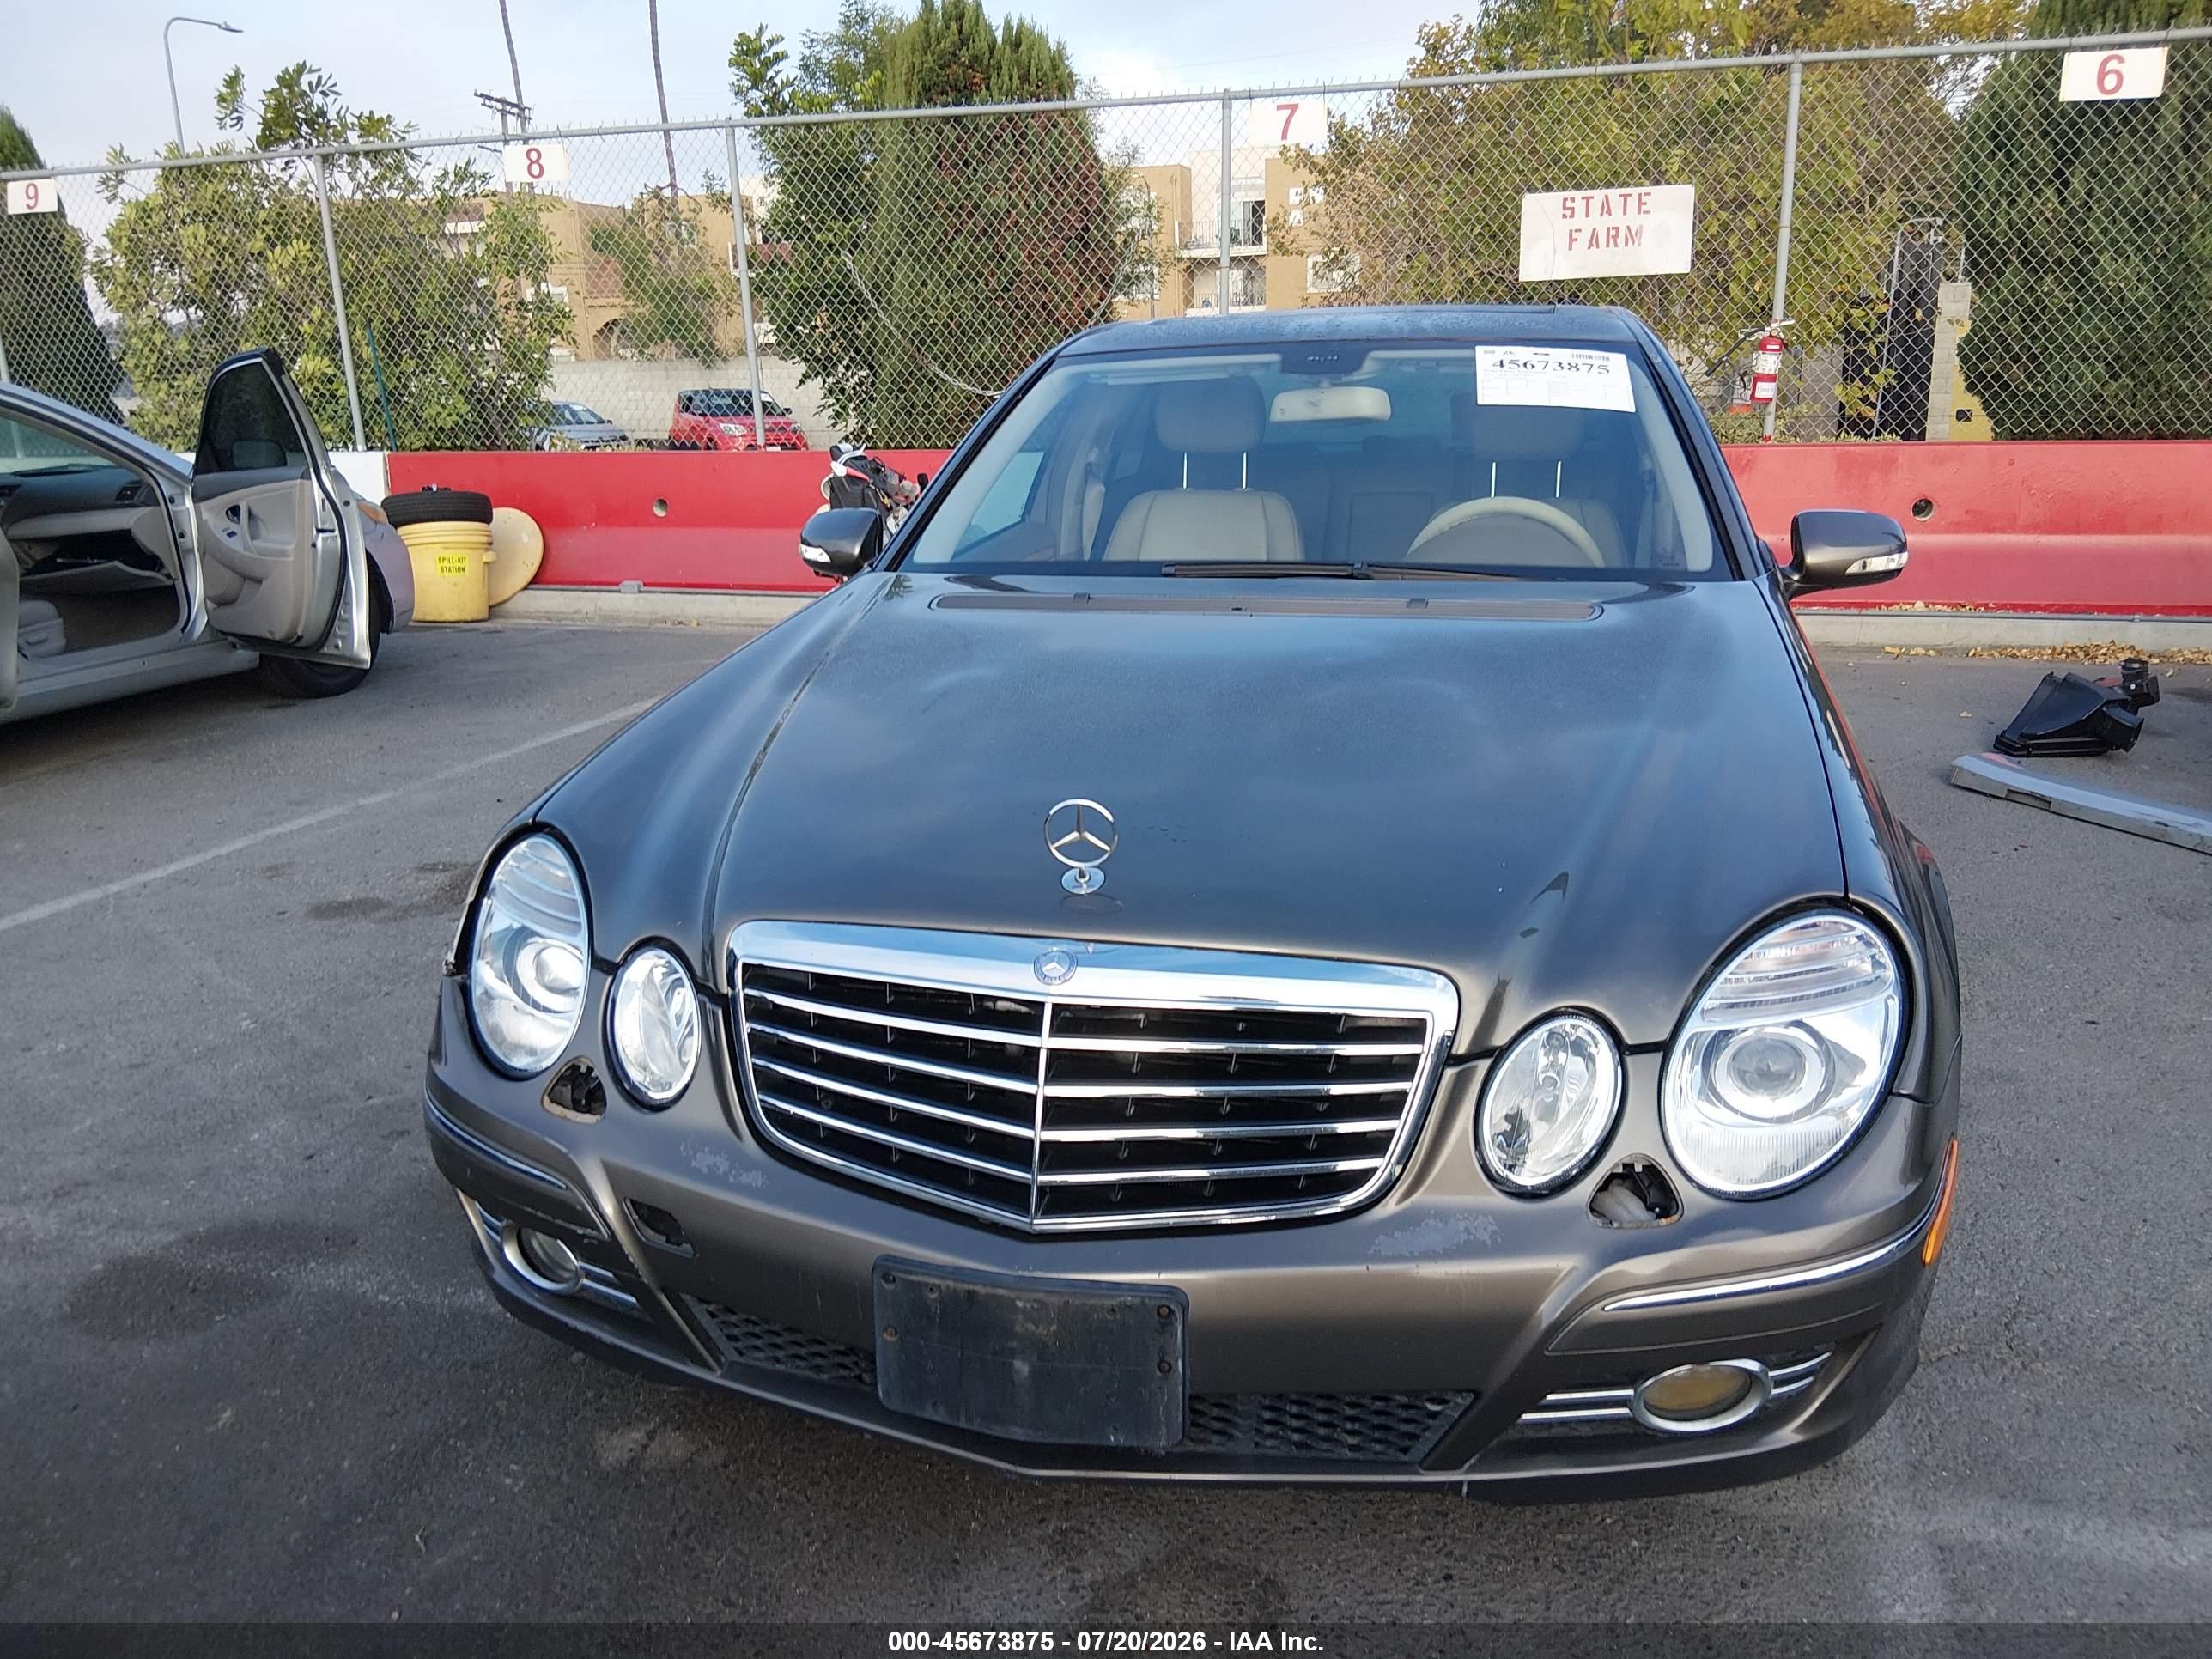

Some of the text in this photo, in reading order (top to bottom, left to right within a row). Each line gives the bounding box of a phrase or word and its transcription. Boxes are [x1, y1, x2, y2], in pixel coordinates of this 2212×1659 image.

[2096, 53, 2125, 95] 6
[1276, 103, 1299, 141] 7
[526, 147, 544, 179] 8
[25, 183, 40, 210] 9
[1561, 191, 1652, 220] STATE
[1567, 224, 1643, 251] FARM
[1492, 358, 1611, 375] 45673875
[438, 556, 467, 564] SPILL-KIT
[441, 565, 465, 574] STATION
